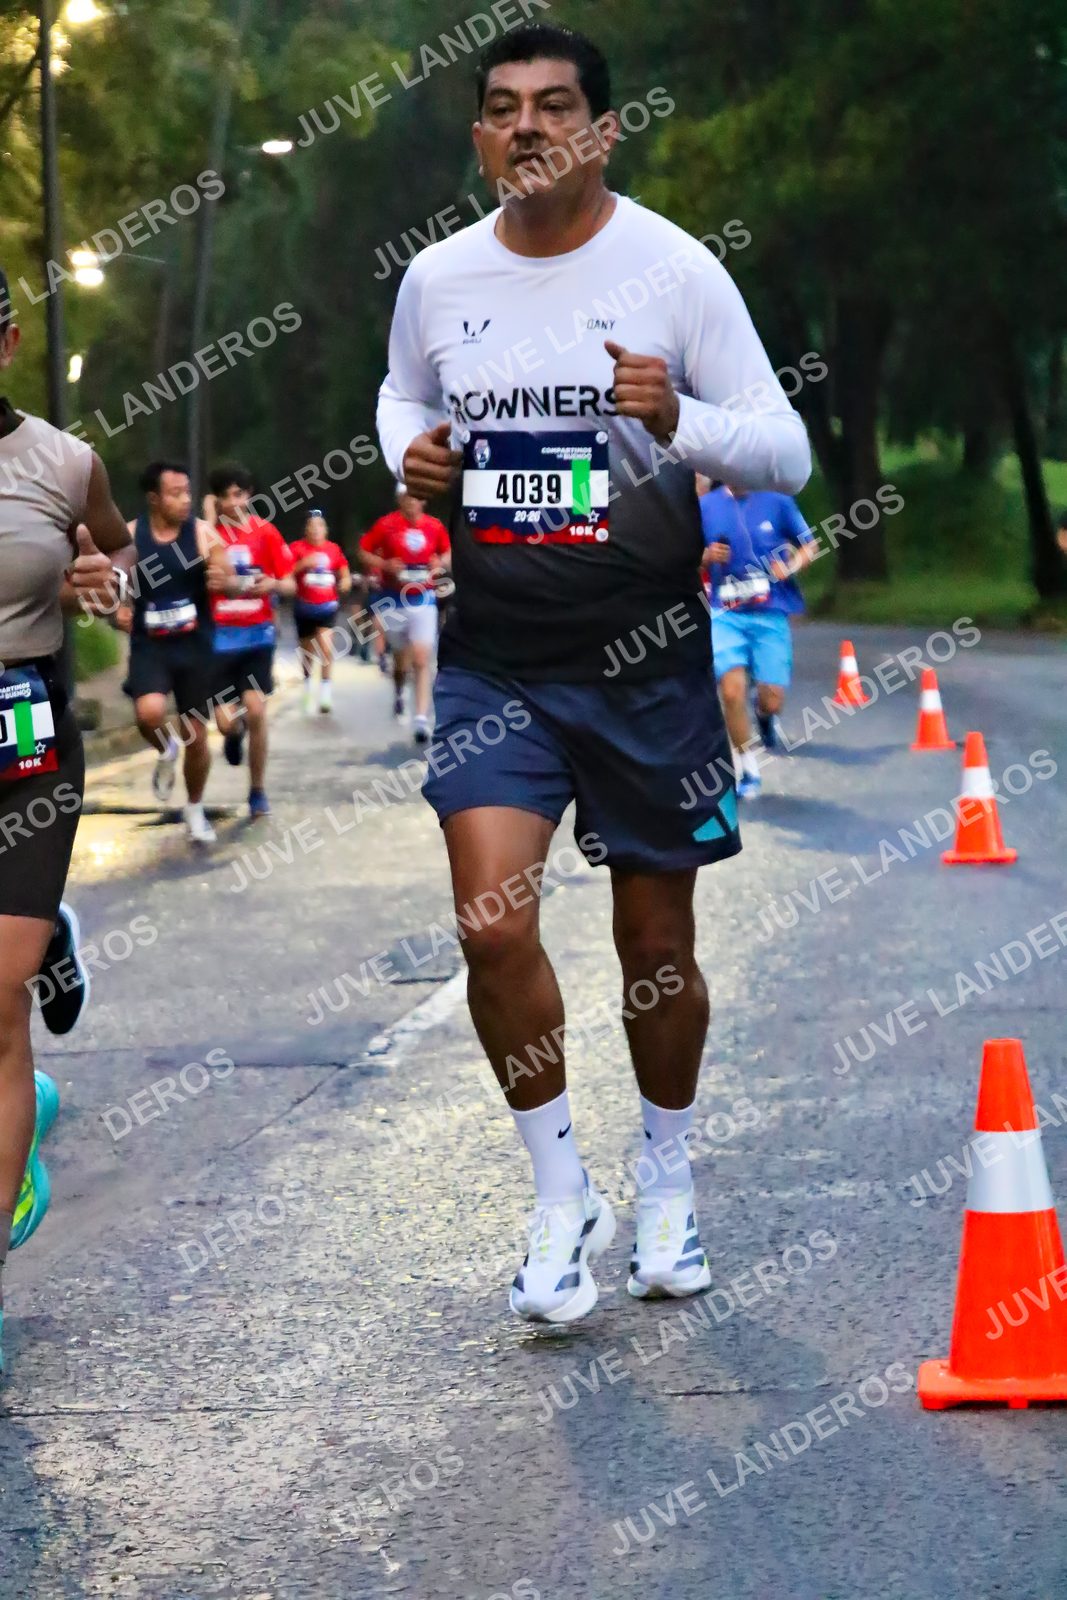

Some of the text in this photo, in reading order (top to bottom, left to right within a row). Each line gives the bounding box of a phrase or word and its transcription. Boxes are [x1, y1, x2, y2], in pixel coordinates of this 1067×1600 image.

[496, 474, 562, 504] 4039
[569, 525, 594, 536] 10K
[19, 757, 42, 770] 10K
